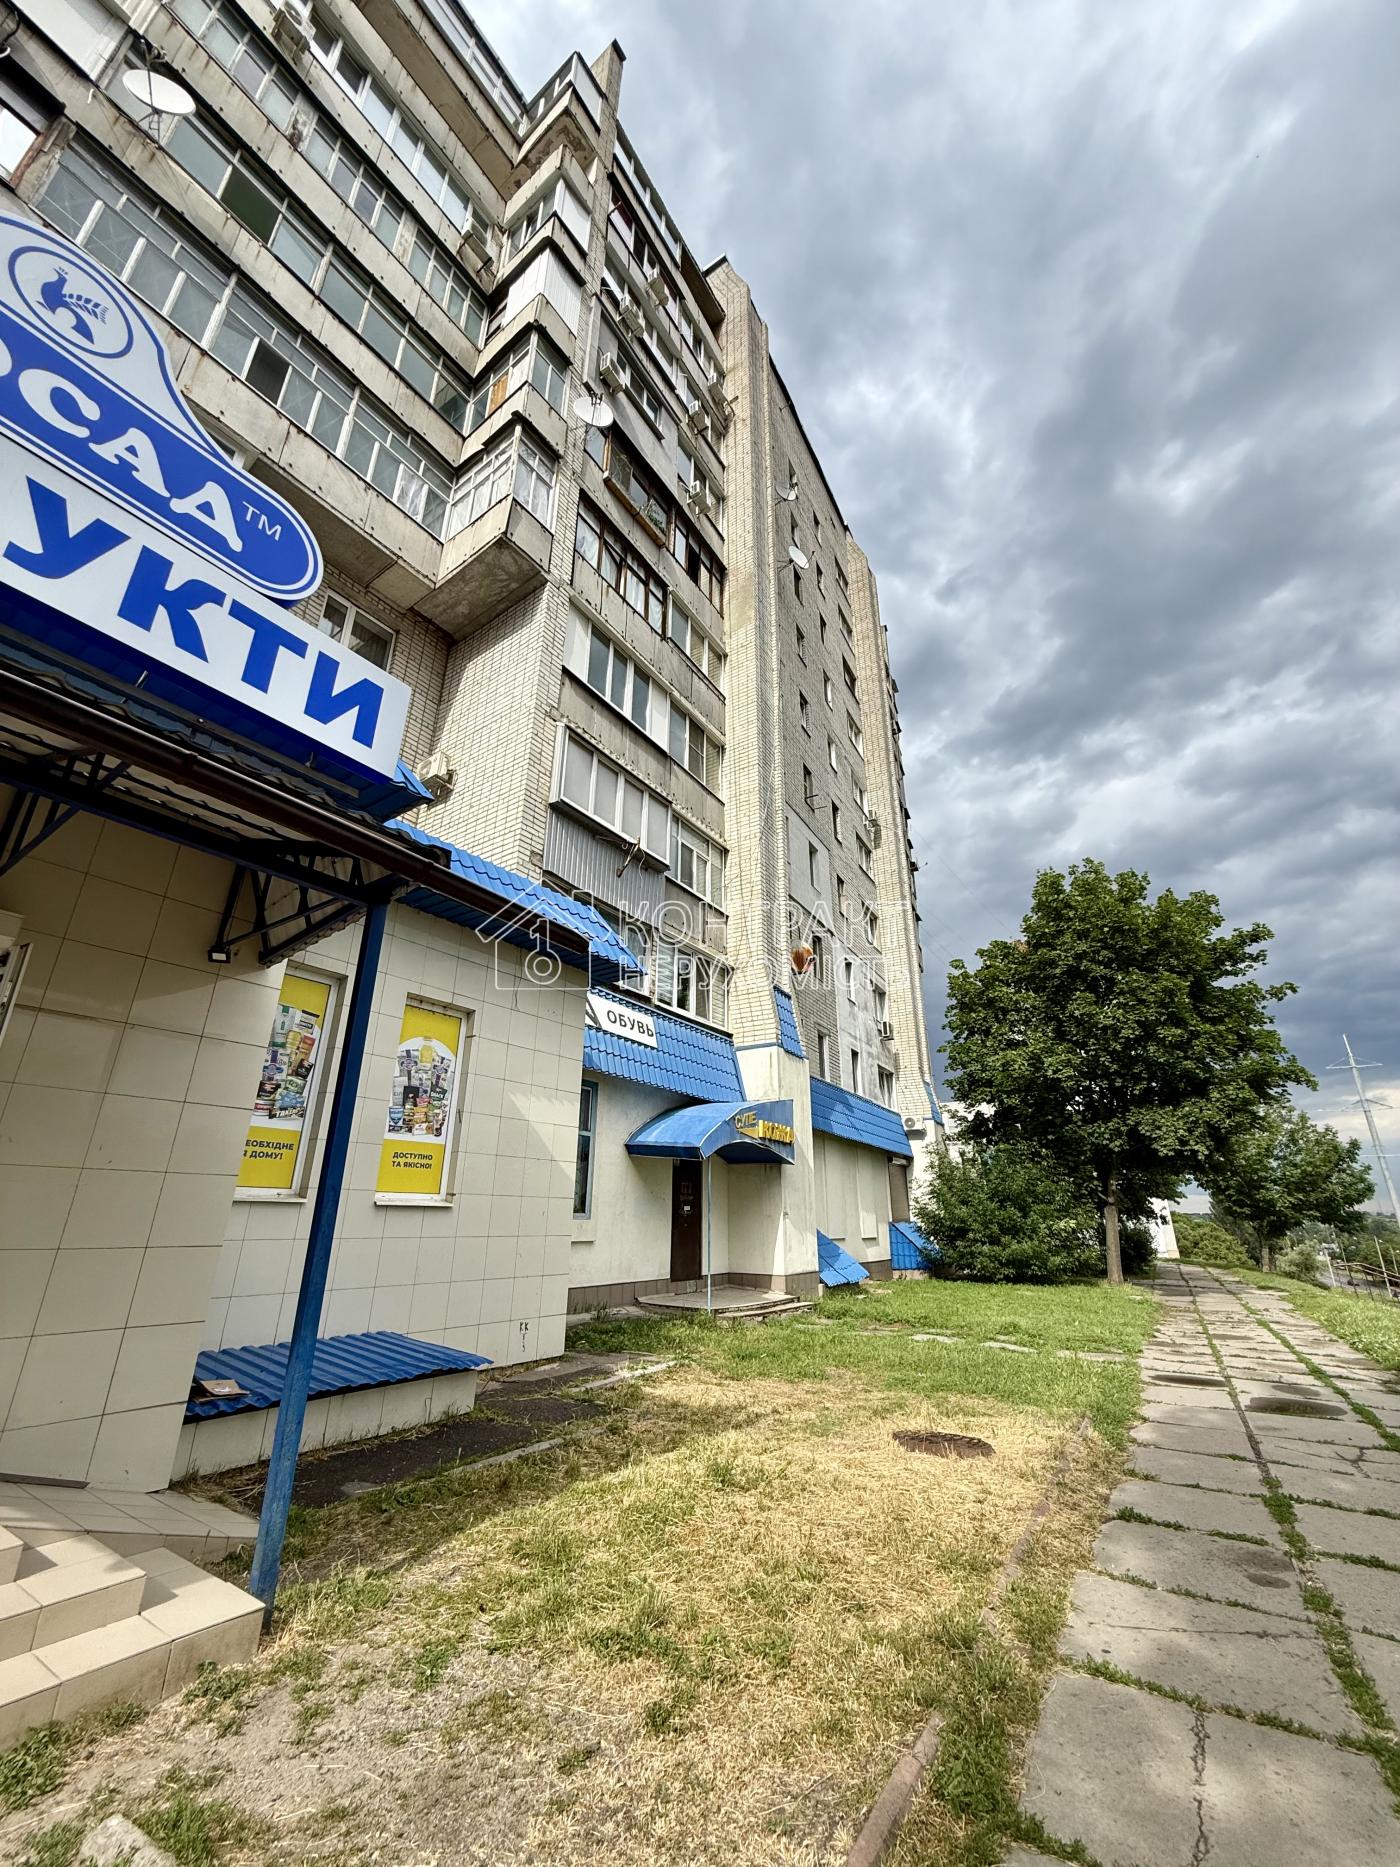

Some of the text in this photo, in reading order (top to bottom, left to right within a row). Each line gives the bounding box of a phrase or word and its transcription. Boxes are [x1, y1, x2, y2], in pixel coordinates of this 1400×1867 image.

[607, 1010, 654, 1037] ОБУВЬ
[249, 1150, 284, 1160] ДОМУ!
[392, 1151, 433, 1161] ДОСТУПНО
[392, 1160, 432, 1170] ТА ЯКІСНО!
